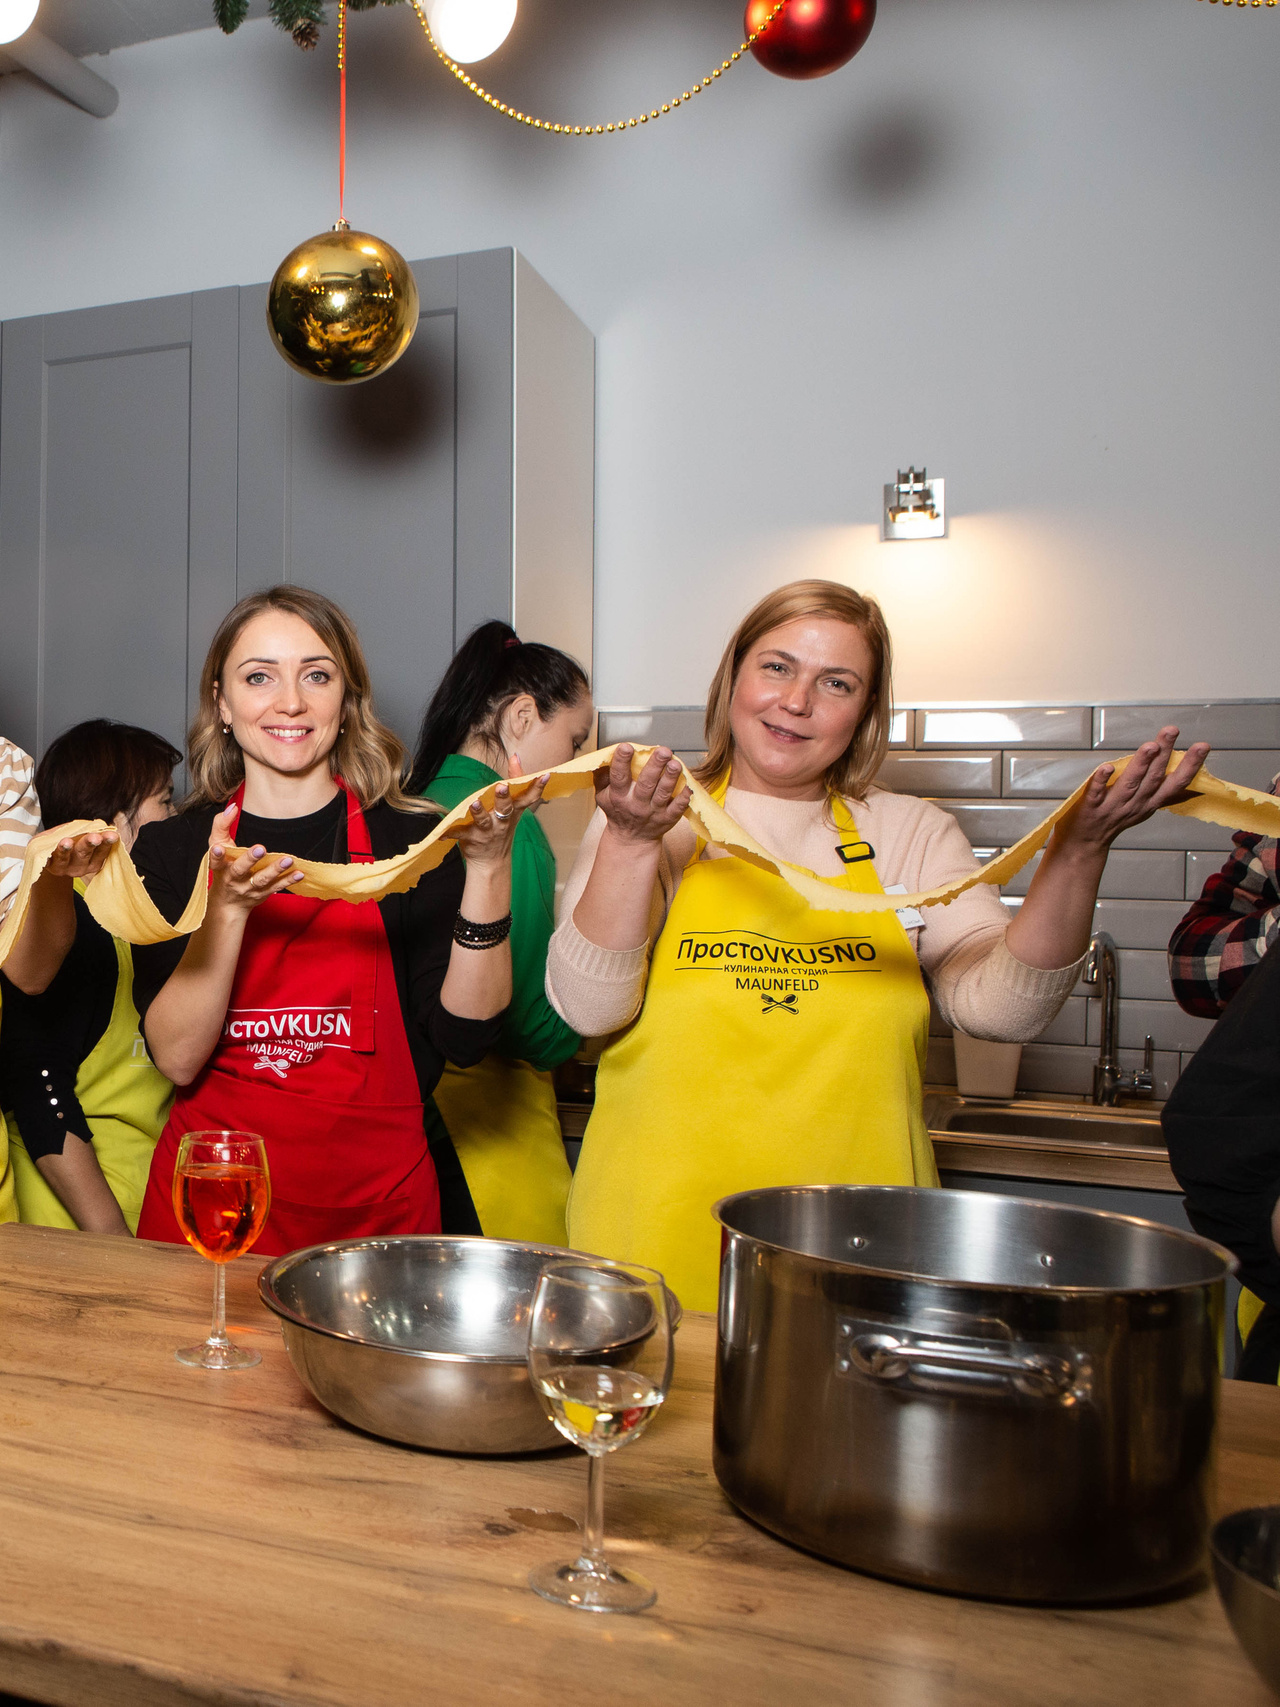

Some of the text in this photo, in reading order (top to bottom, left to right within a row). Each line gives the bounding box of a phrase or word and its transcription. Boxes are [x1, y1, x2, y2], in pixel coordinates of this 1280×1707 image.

[723, 964, 829, 976] КУЛИНАРНАЯ СТУДИЯ
[735, 977, 820, 991] MAUNFELD
[246, 1041, 313, 1064] MAUNFELD
[294, 1038, 324, 1053] СТУДИЯ
